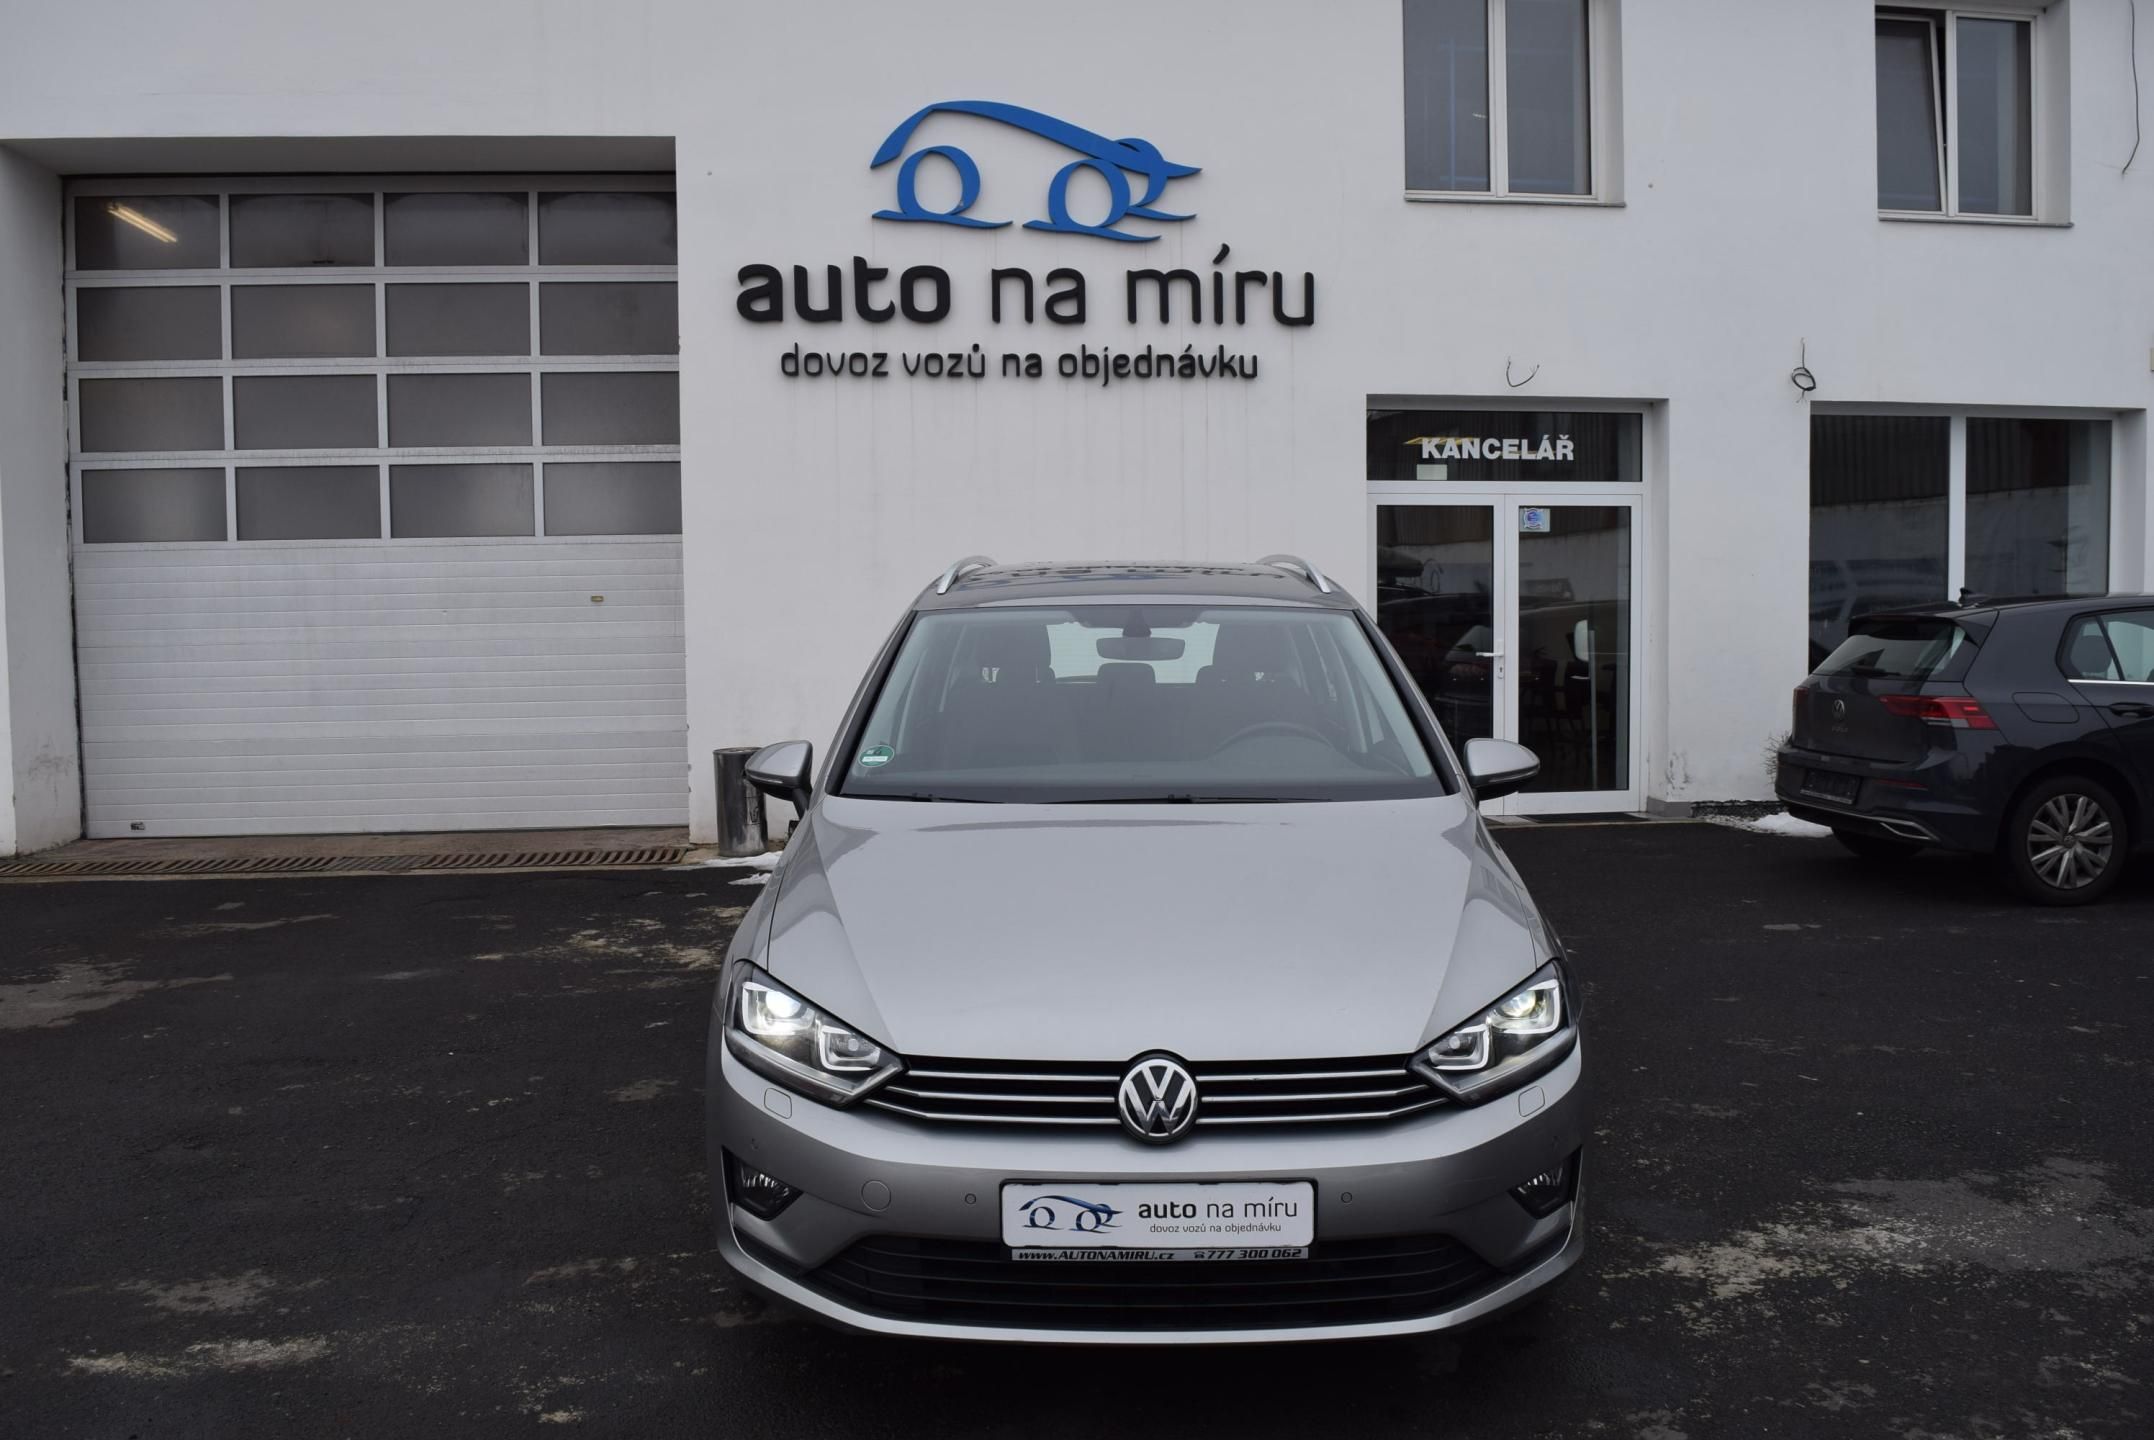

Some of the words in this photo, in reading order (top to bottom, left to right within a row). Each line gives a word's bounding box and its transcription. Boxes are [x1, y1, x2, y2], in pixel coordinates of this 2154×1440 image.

[736, 255, 951, 323] auto
[991, 267, 1087, 325] na
[1126, 243, 1315, 326] míru
[780, 342, 888, 378] dovoz
[903, 343, 986, 378] vozů
[1002, 352, 1043, 378] na
[1057, 344, 1259, 387] objednávku
[1421, 434, 1575, 461] KANCELÁŘ
[1138, 1201, 1197, 1219] auto
[1206, 1202, 1234, 1218] na
[1244, 1196, 1298, 1218] míru
[1149, 1224, 1180, 1233] dovoz
[1182, 1223, 1207, 1233] vozů
[1209, 1225, 1222, 1233] na
[1225, 1222, 1282, 1235] objednávku
[1238, 1249, 1268, 1260] 300
[1271, 1248, 1302, 1259] 062
